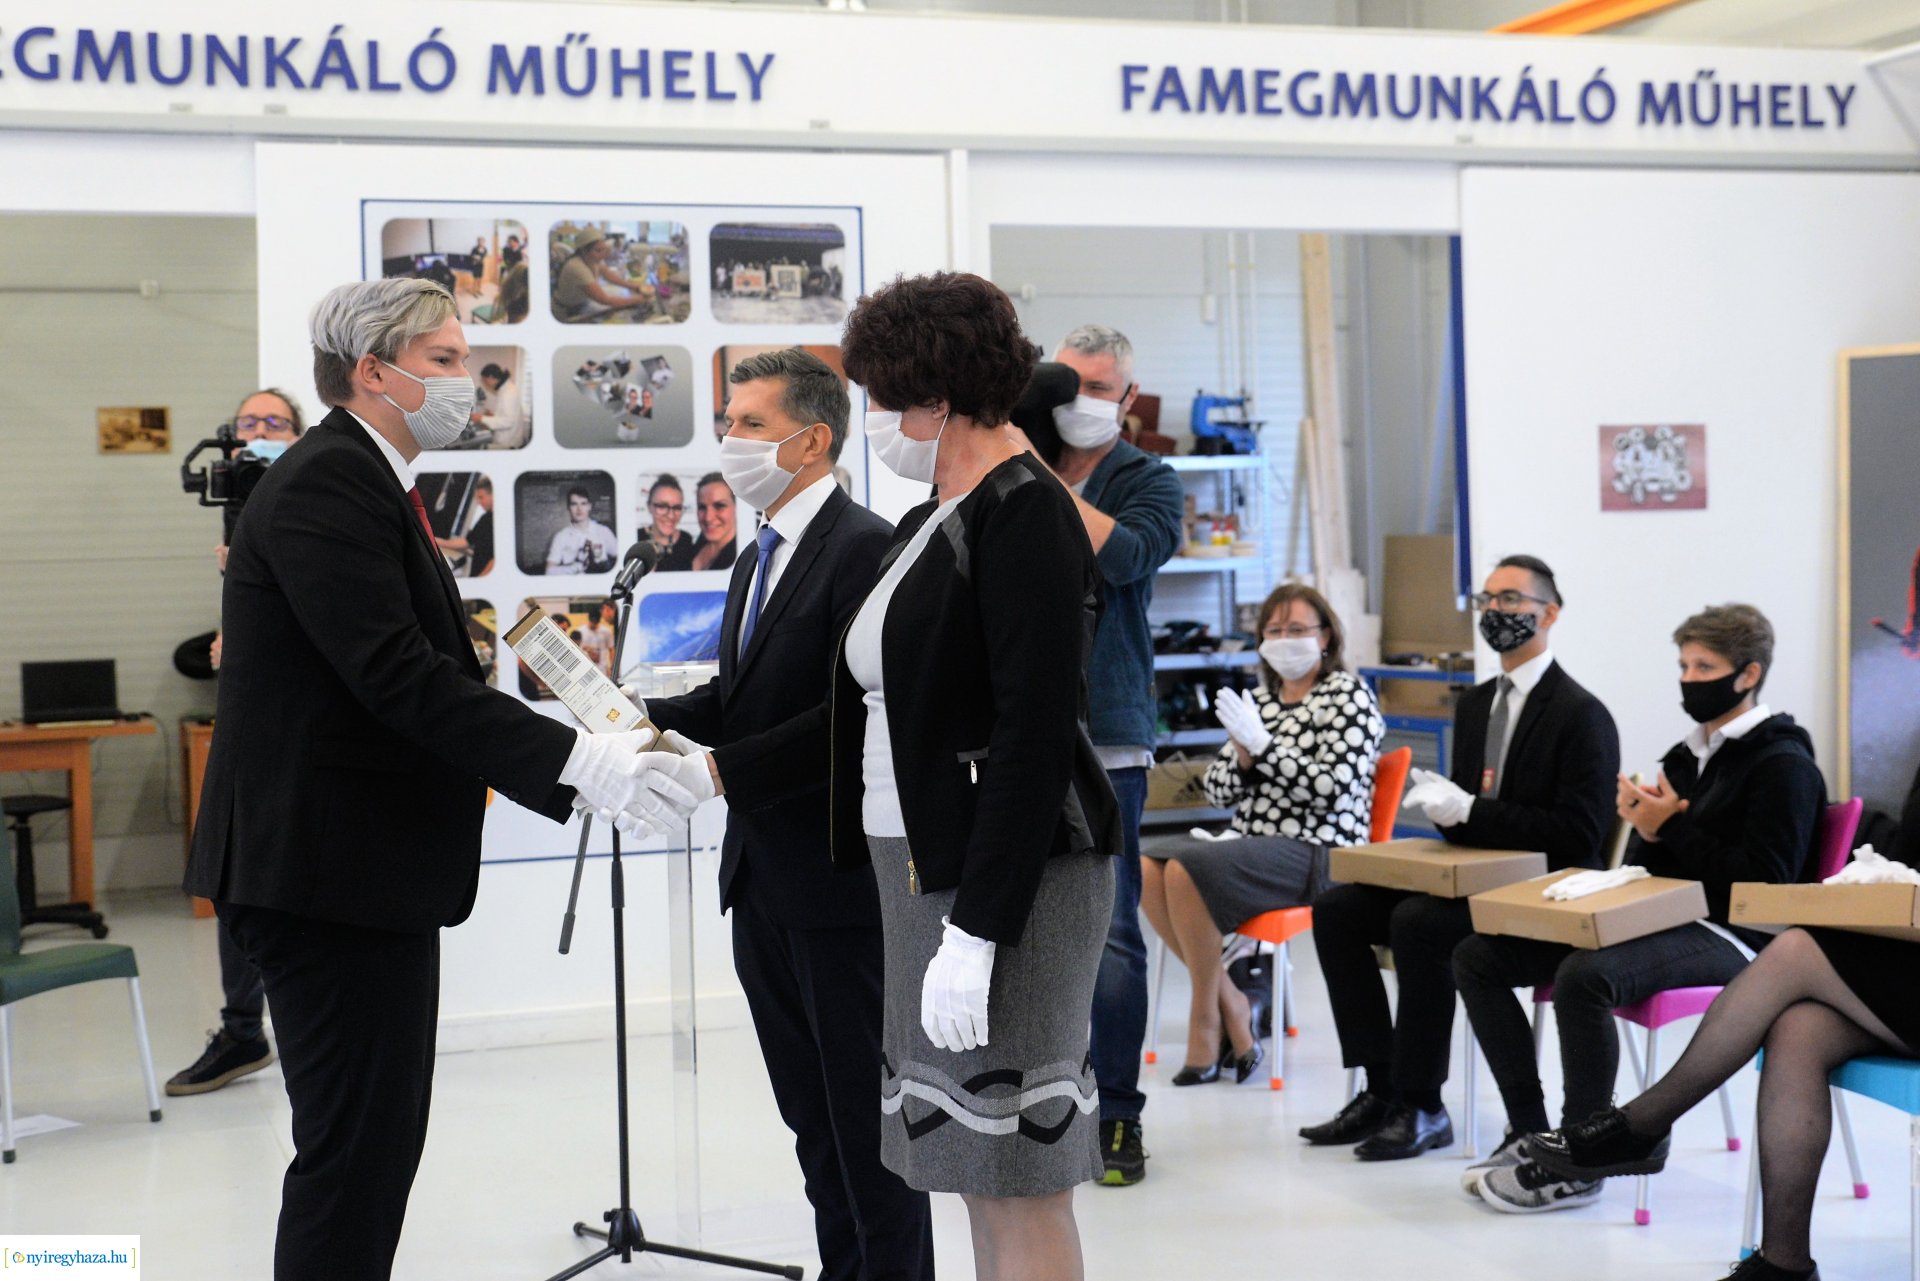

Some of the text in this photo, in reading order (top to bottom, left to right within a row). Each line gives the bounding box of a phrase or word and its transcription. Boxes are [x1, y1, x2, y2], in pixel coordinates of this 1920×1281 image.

[0, 25, 776, 102] GMUNKÁLÓ MŰHELY
[1122, 64, 1857, 128] FAMEGMUNKÁLÓ MŰHELY
